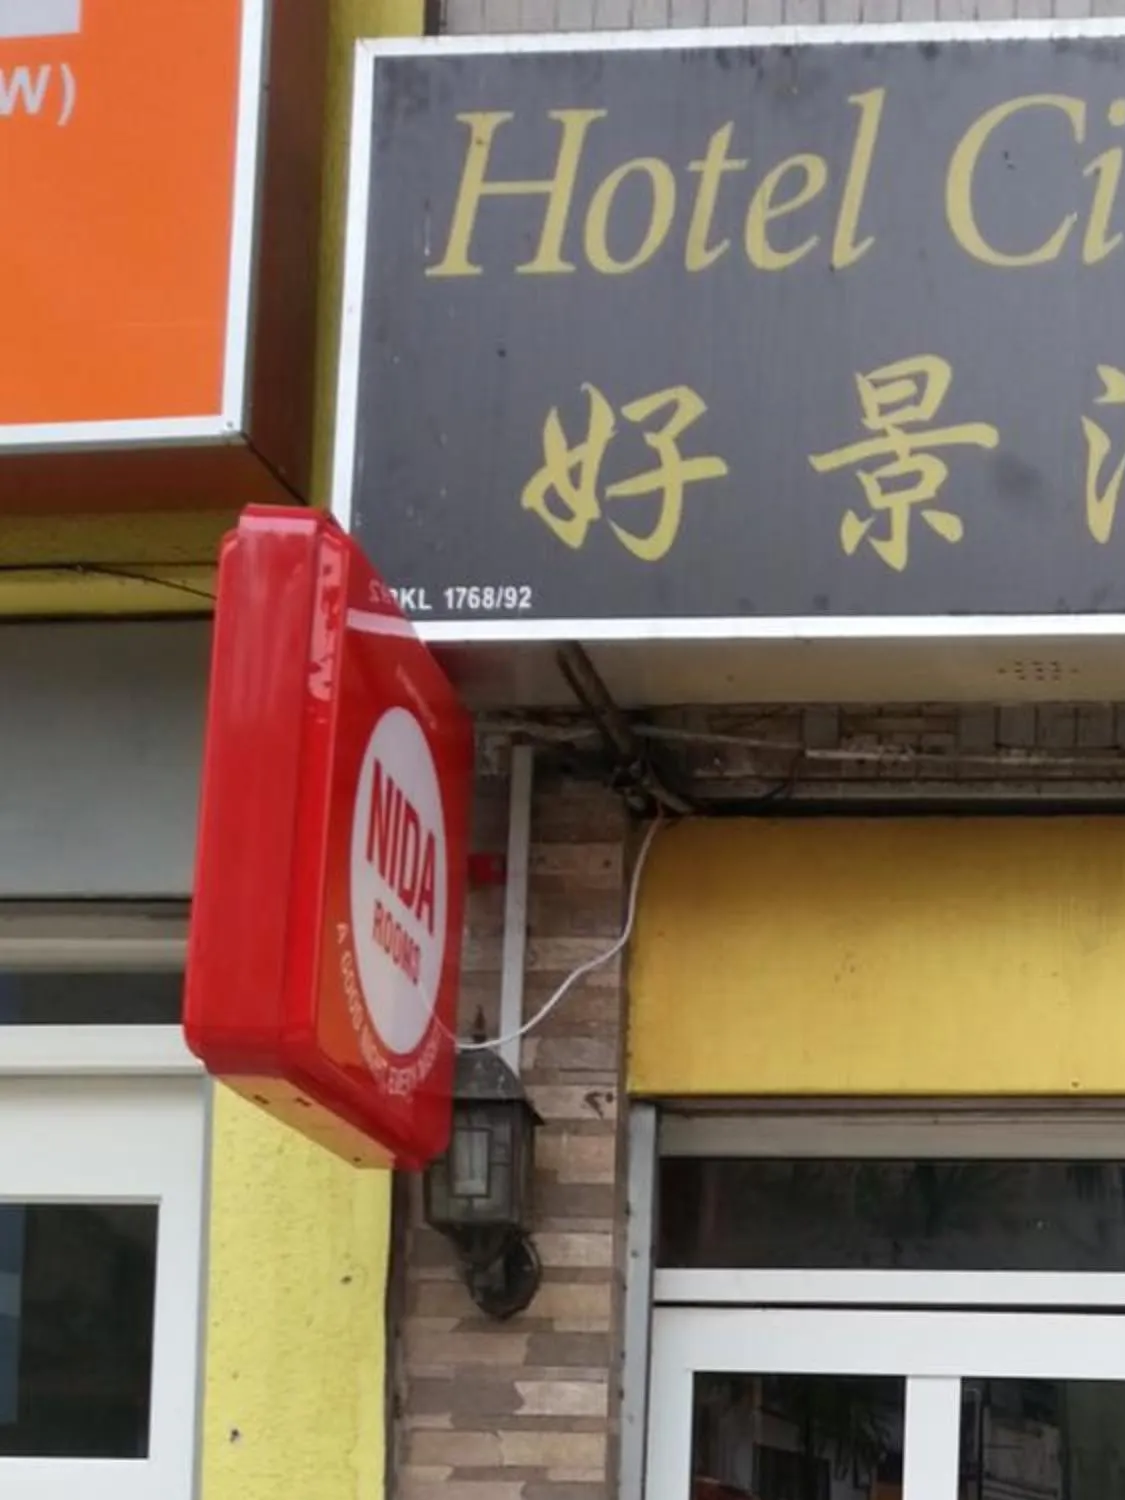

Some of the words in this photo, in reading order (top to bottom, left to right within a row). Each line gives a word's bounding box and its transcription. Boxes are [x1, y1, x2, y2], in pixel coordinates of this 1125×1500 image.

[425, 88, 886, 276] Hotel
[443, 584, 532, 610] 1768/92
[366, 758, 436, 938] NIDA
[372, 898, 422, 986] ROOMS
